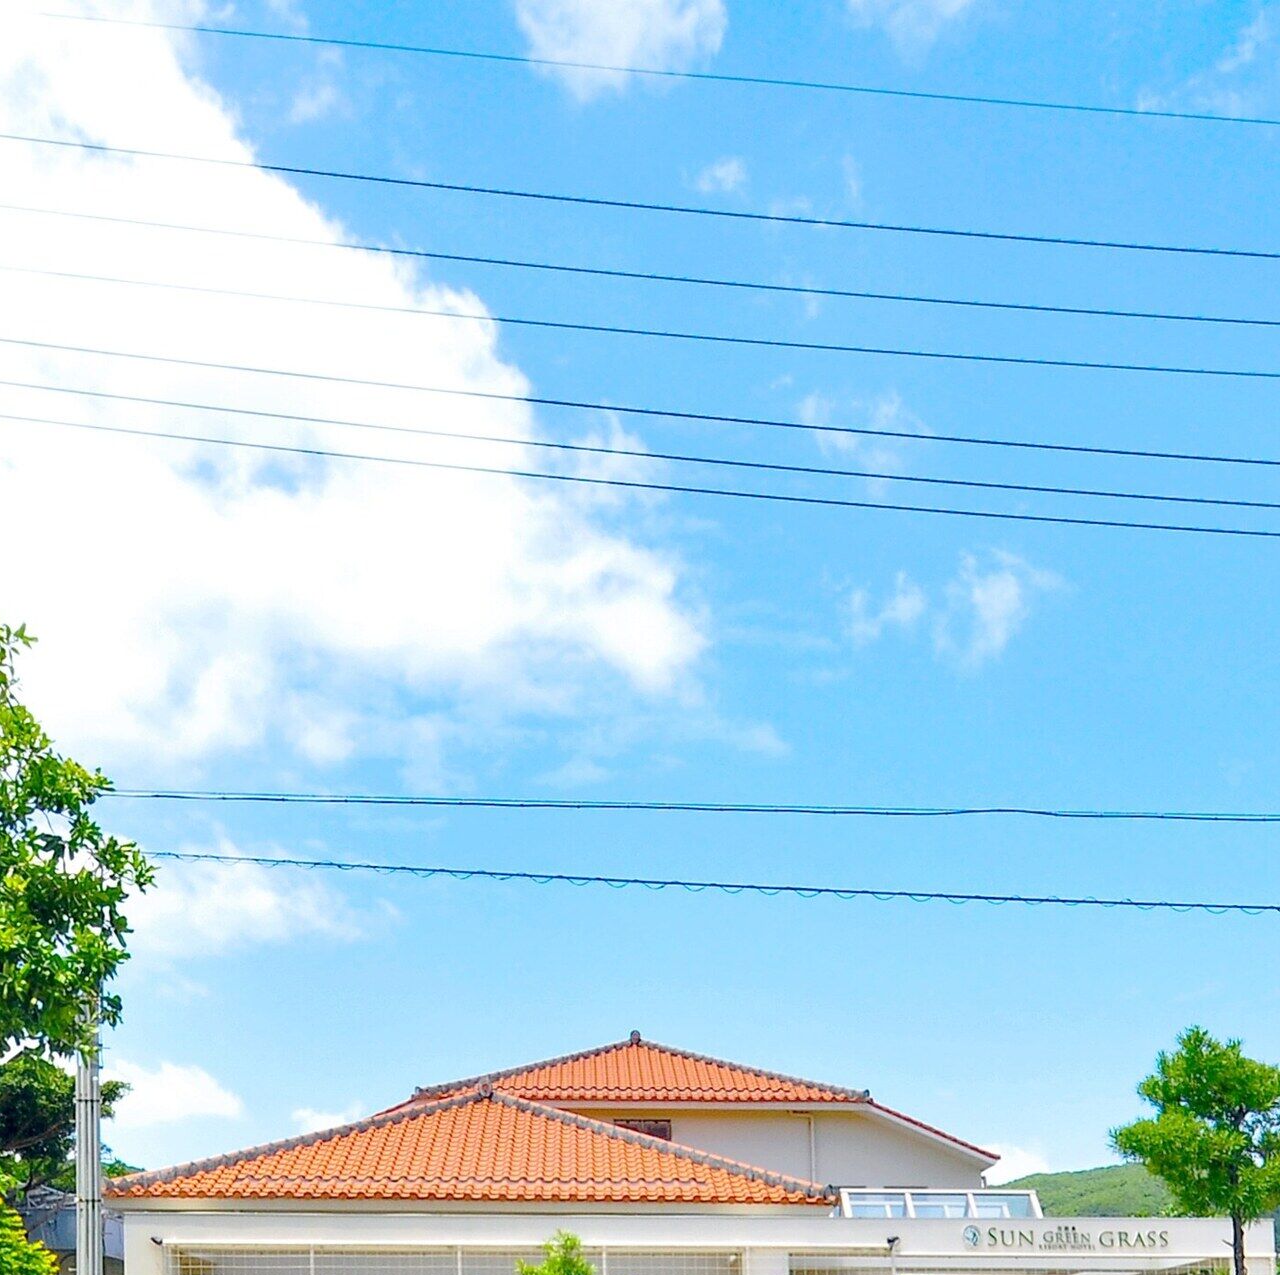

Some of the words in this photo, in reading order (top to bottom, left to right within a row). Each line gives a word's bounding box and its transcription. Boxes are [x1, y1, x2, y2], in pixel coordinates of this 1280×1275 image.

[987, 1227, 1034, 1247] SUN
[1043, 1230, 1090, 1244] GREEN
[1099, 1230, 1169, 1248] GRASS
